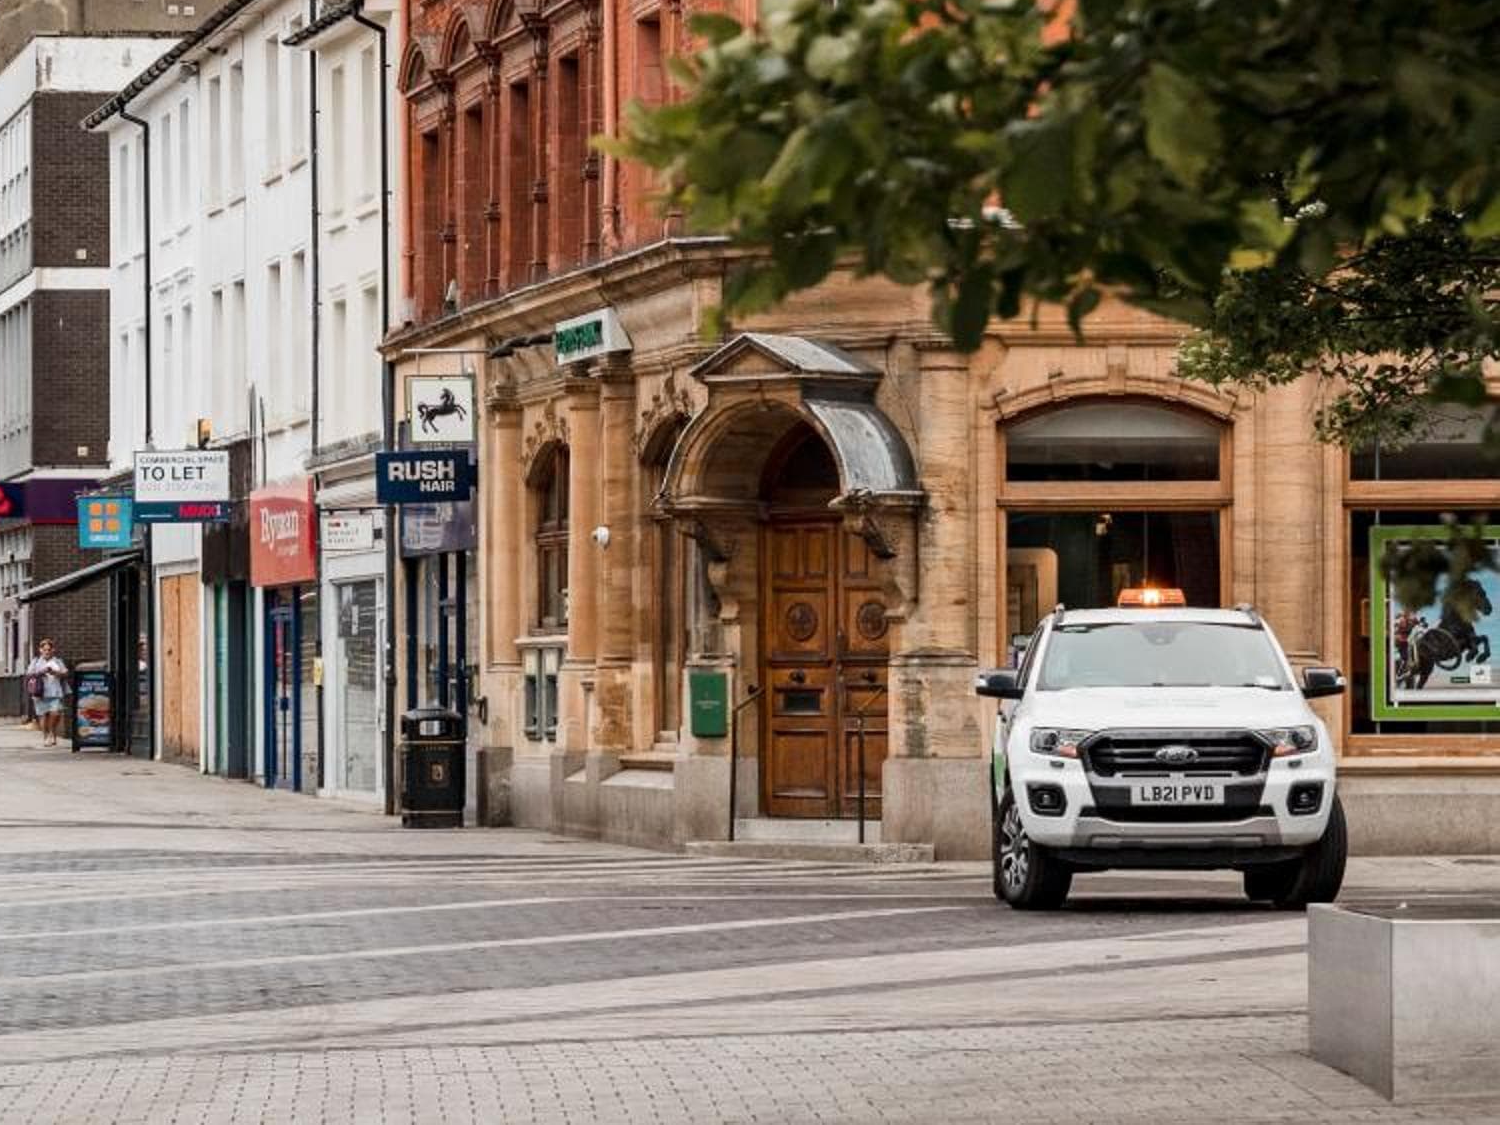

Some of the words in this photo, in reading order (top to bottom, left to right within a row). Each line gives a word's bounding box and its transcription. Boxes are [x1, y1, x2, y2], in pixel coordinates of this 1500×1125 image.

[140, 466, 165, 481] TO
[171, 465, 206, 481] LET
[387, 459, 455, 482] RUSH
[420, 480, 455, 492] HAIR
[1141, 786, 1177, 801] LB21
[1182, 785, 1214, 800] PVD
